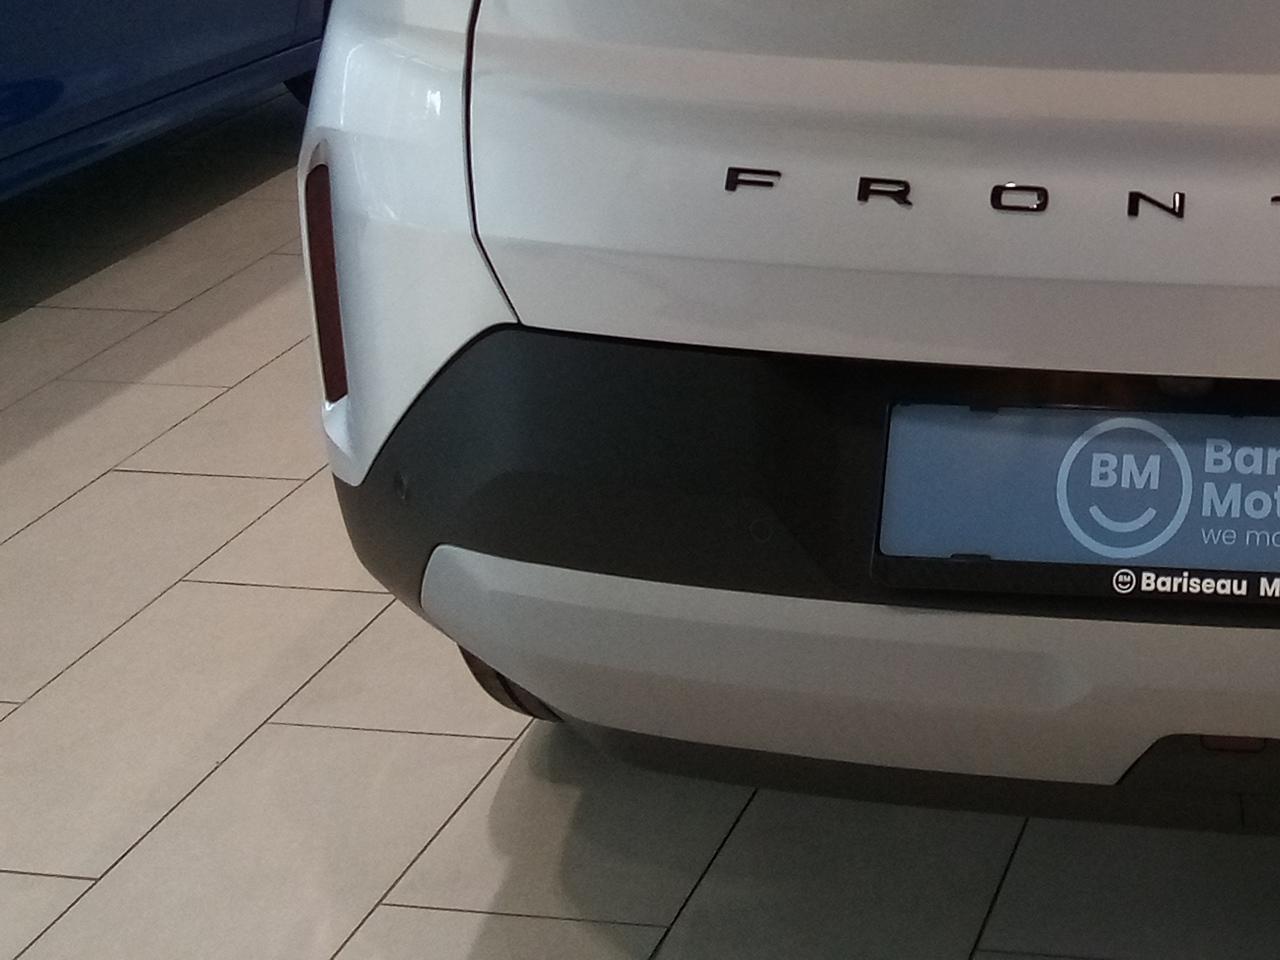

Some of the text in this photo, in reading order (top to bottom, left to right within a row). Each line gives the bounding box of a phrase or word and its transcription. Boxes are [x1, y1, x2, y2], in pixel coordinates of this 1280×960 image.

[1090, 452, 1161, 489] BM
[1201, 526, 1237, 546] we
[1141, 571, 1248, 596] Bariseau
